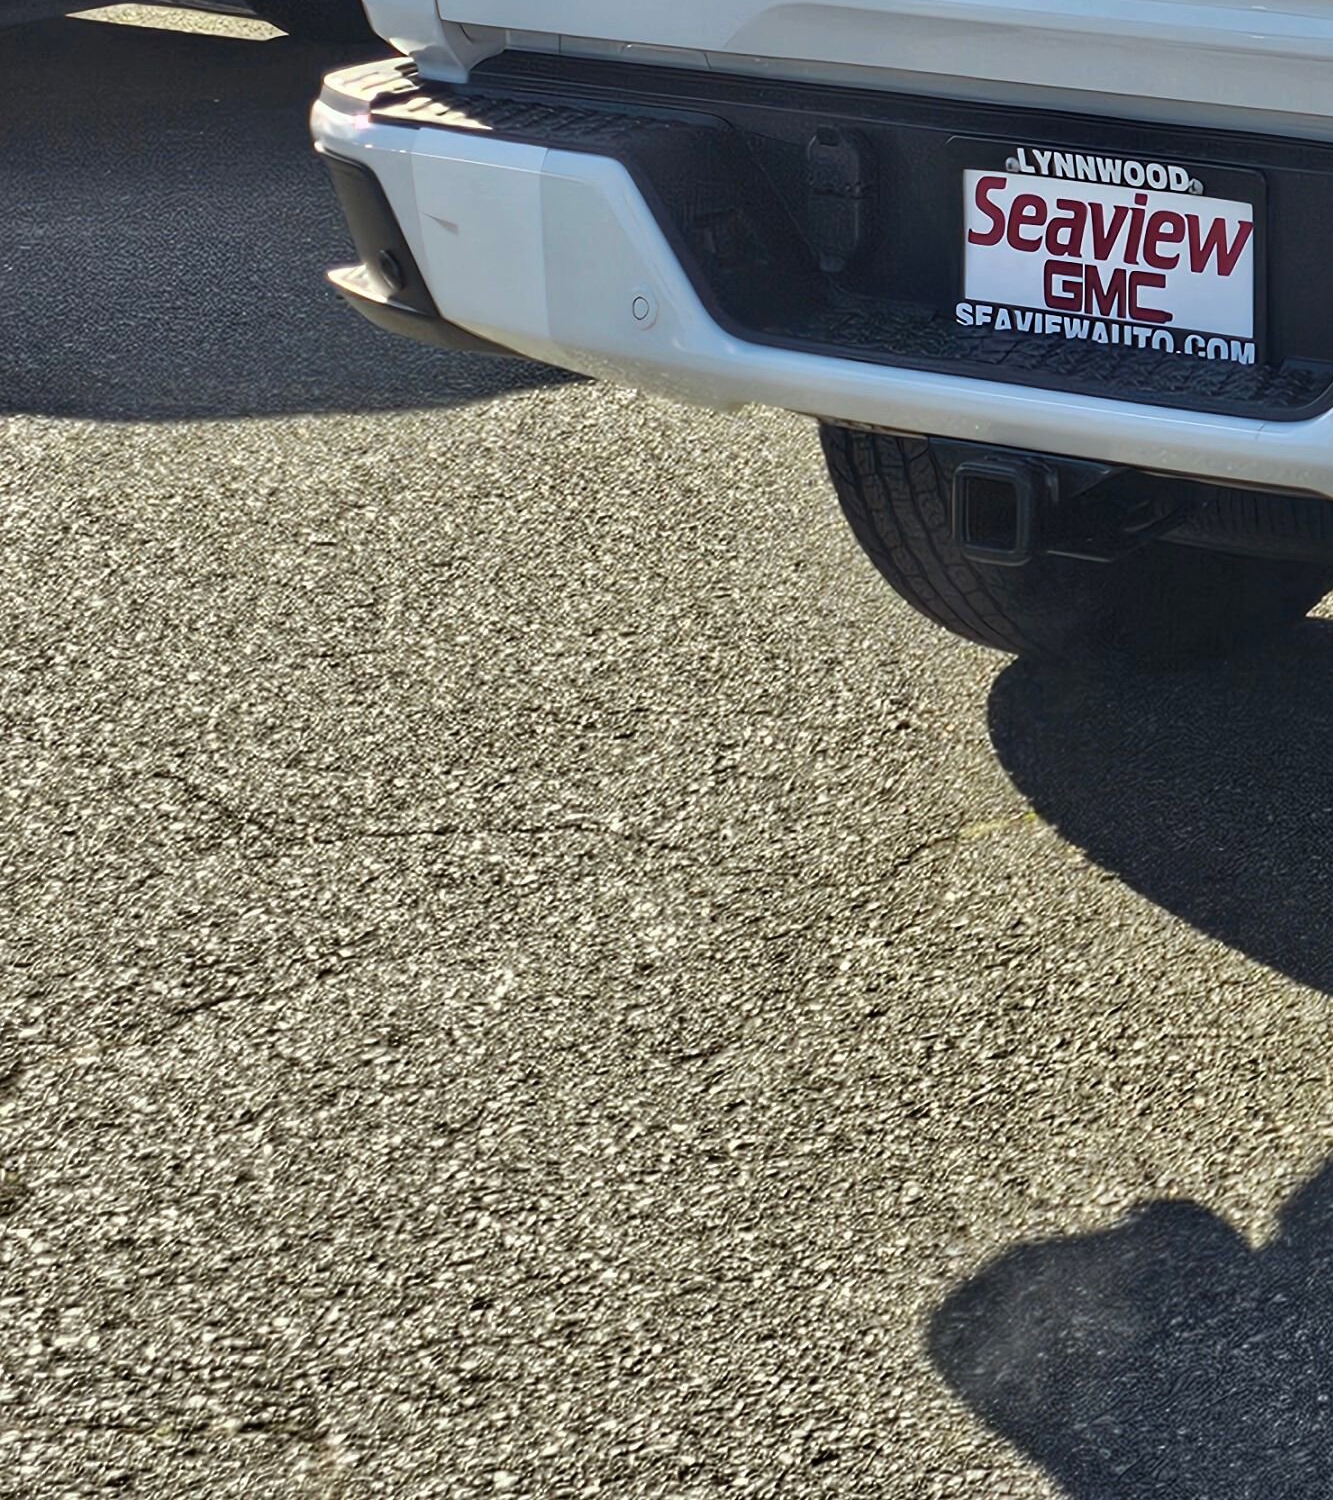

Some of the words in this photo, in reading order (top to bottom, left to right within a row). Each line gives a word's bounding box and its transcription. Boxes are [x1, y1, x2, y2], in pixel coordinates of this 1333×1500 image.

[1016, 148, 1189, 191] LYNNWOOD
[967, 176, 1254, 276] Seaview
[1043, 259, 1173, 323] GMC
[955, 302, 1256, 365] SEAVIEWAUTO.COM
